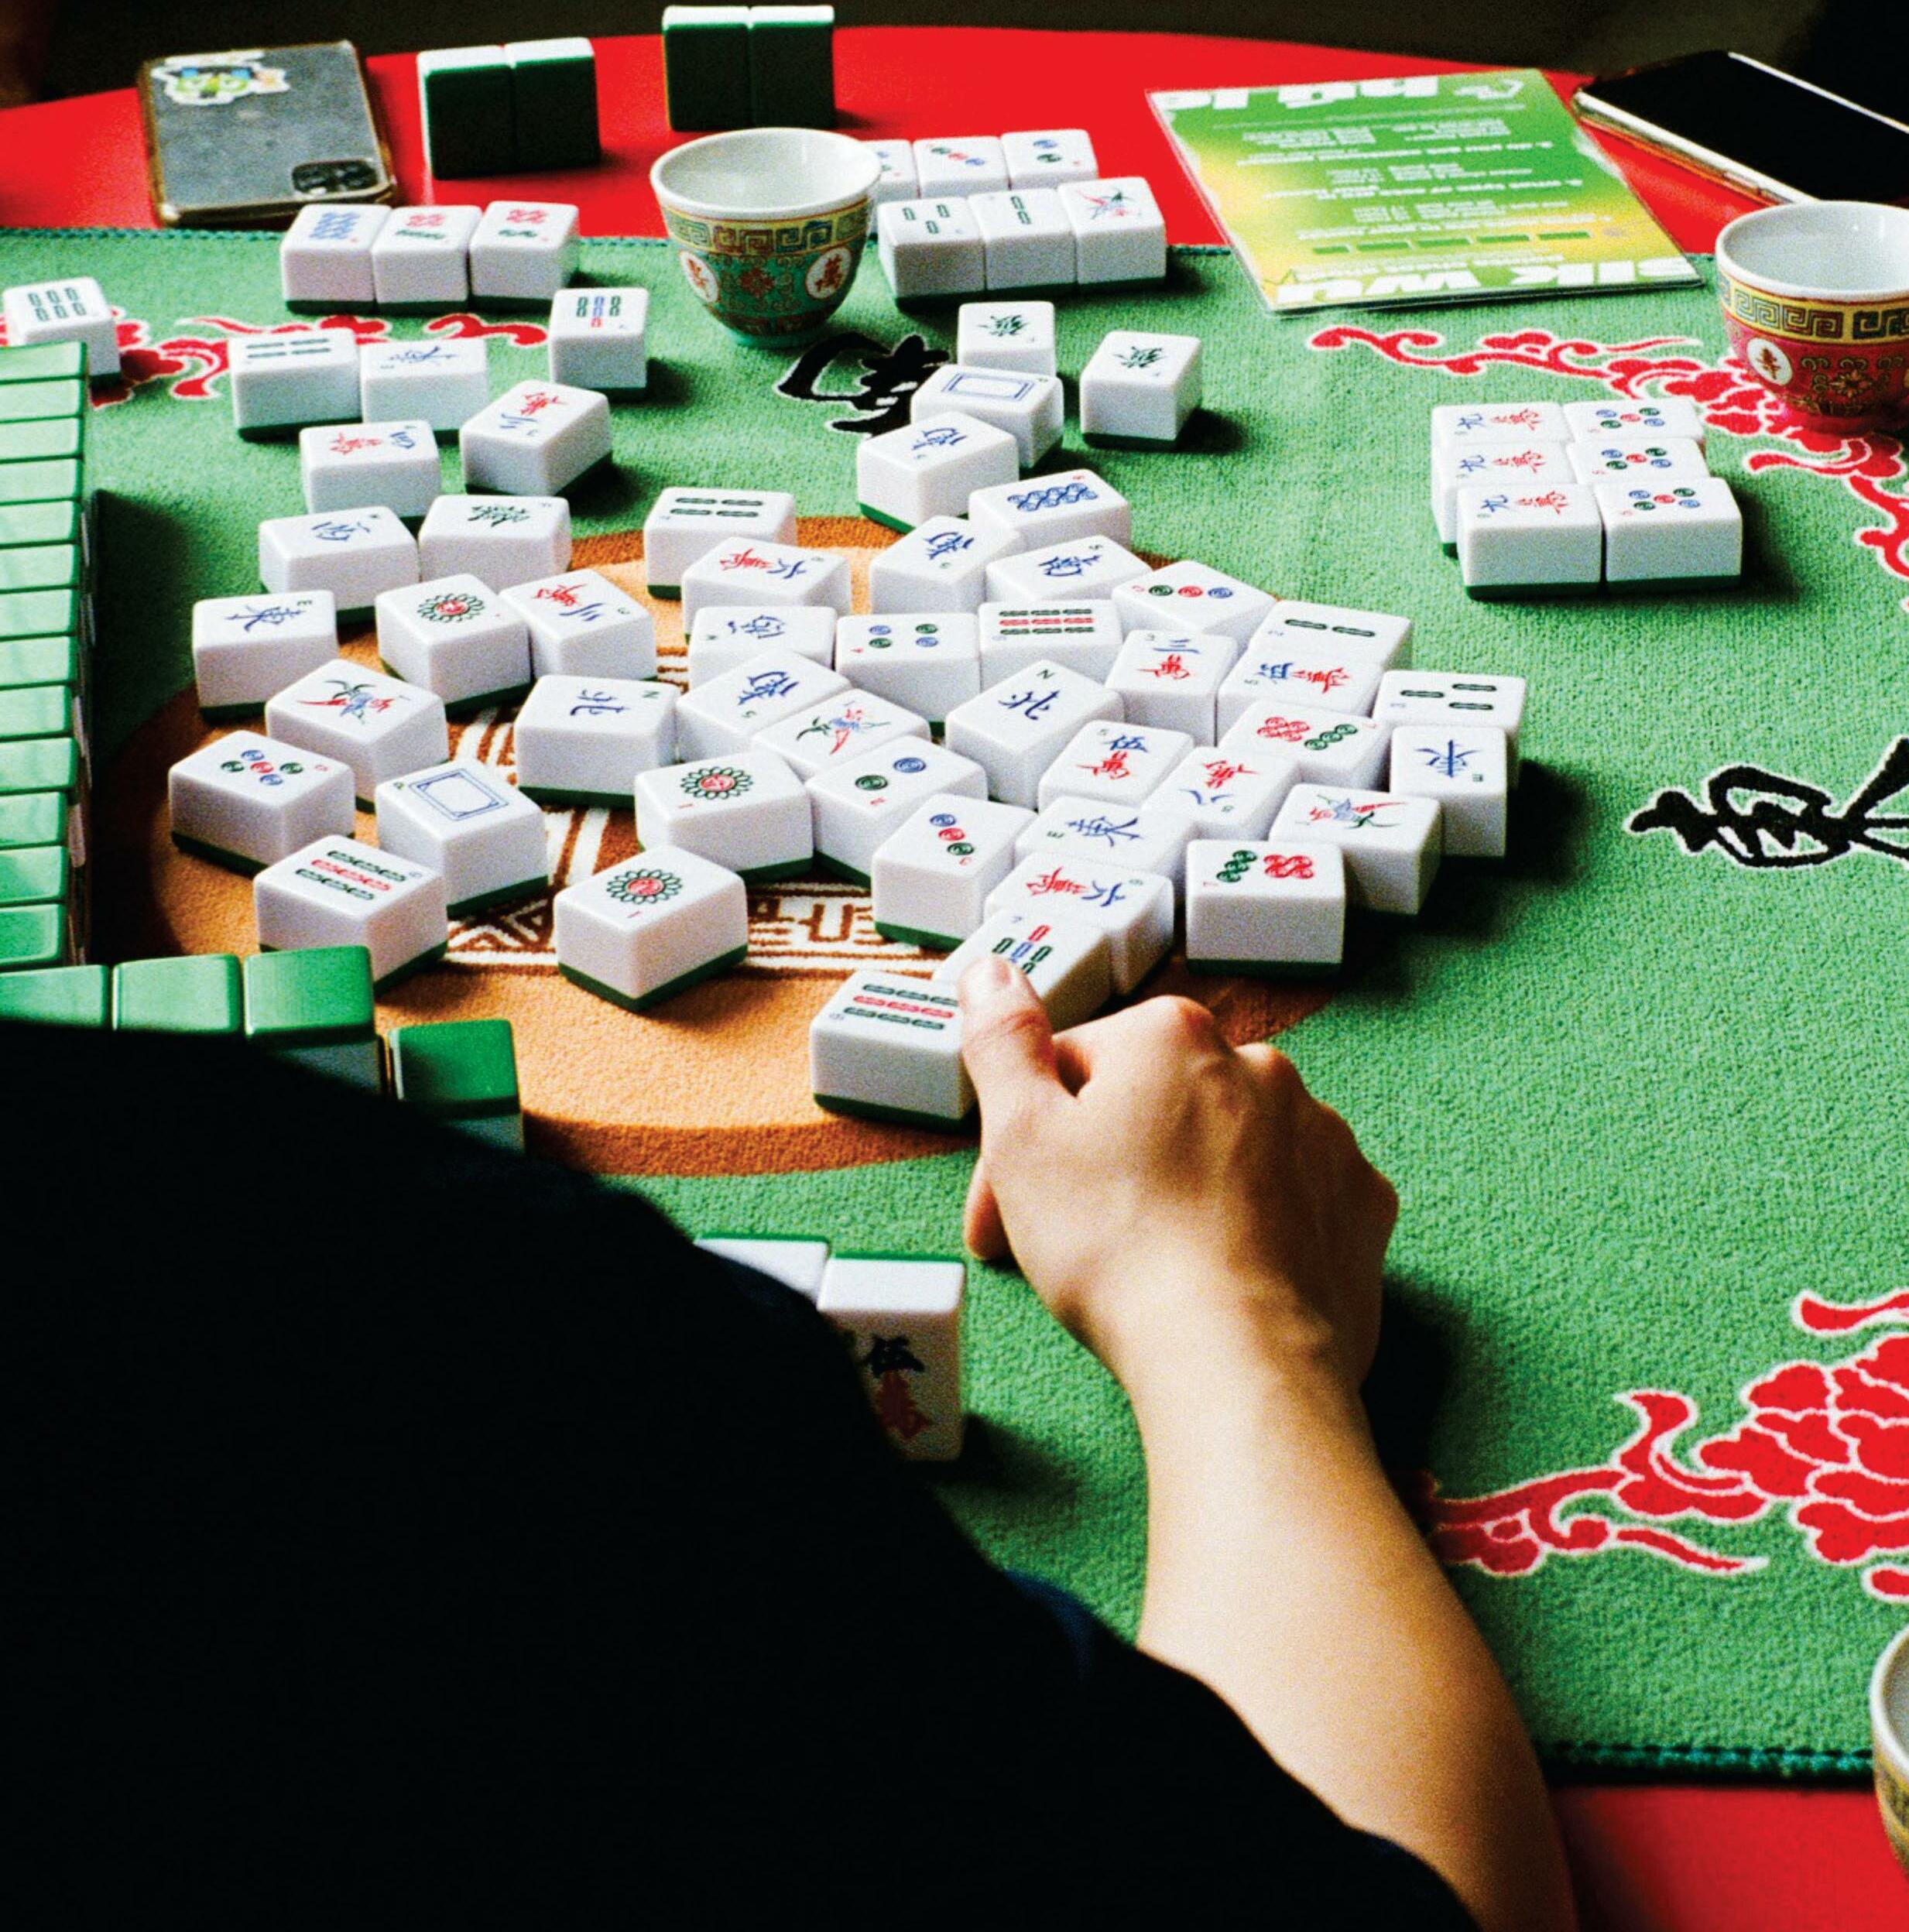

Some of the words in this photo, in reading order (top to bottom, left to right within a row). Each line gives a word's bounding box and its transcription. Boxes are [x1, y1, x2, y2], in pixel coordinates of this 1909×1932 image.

[225, 604, 307, 632] 東
[1139, 637, 1199, 680] 三萬
[1037, 669, 1054, 680] N
[570, 690, 629, 716] 北
[998, 690, 1060, 721] 北
[1415, 739, 1482, 779] 東
[1067, 817, 1140, 847] 東
